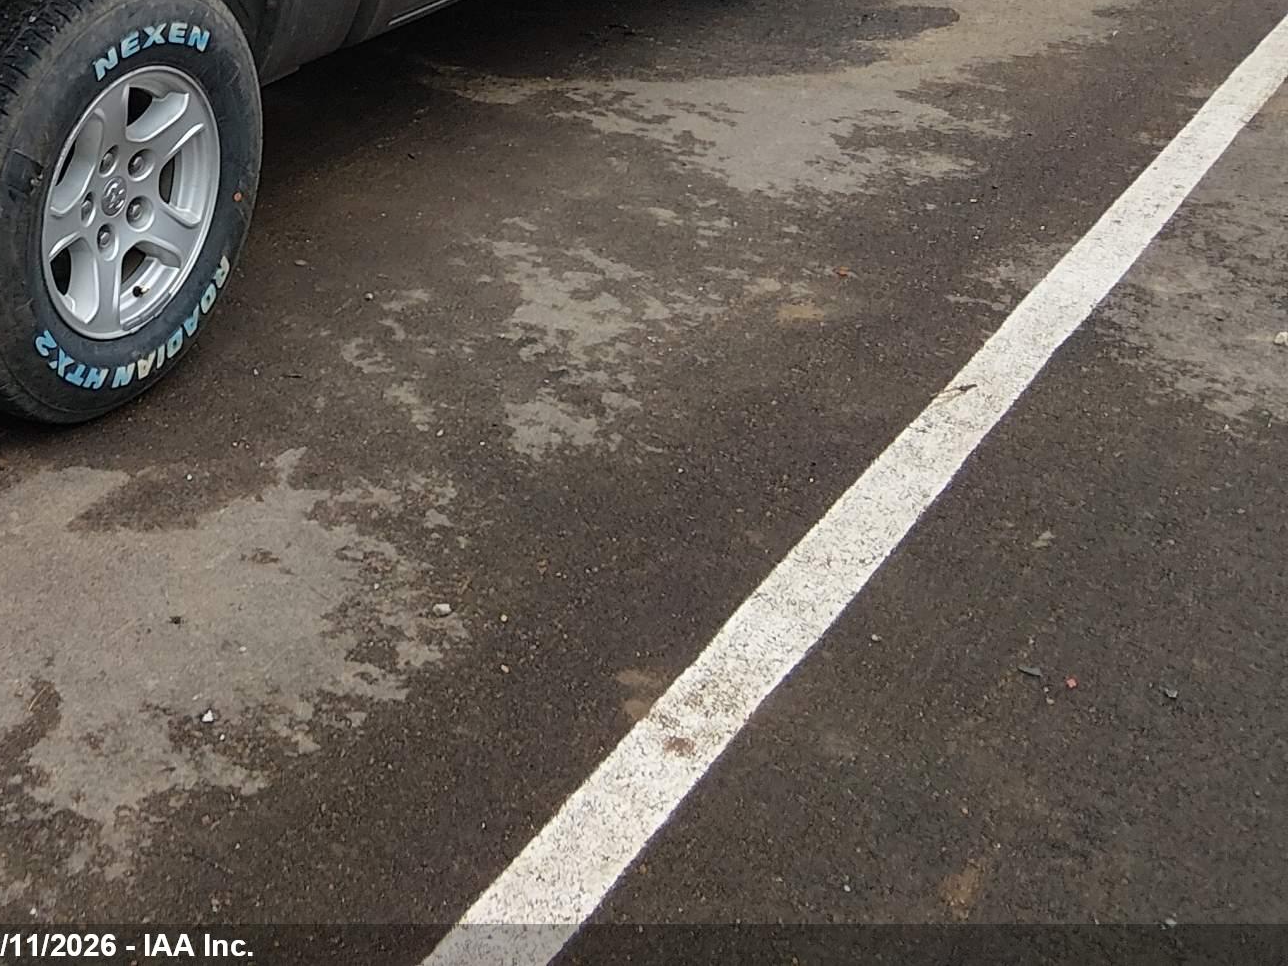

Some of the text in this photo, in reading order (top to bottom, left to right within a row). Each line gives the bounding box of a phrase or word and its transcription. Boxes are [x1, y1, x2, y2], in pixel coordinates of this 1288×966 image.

[92, 22, 210, 82] NEXEN
[35, 255, 230, 390] ROADIAN HTX2
